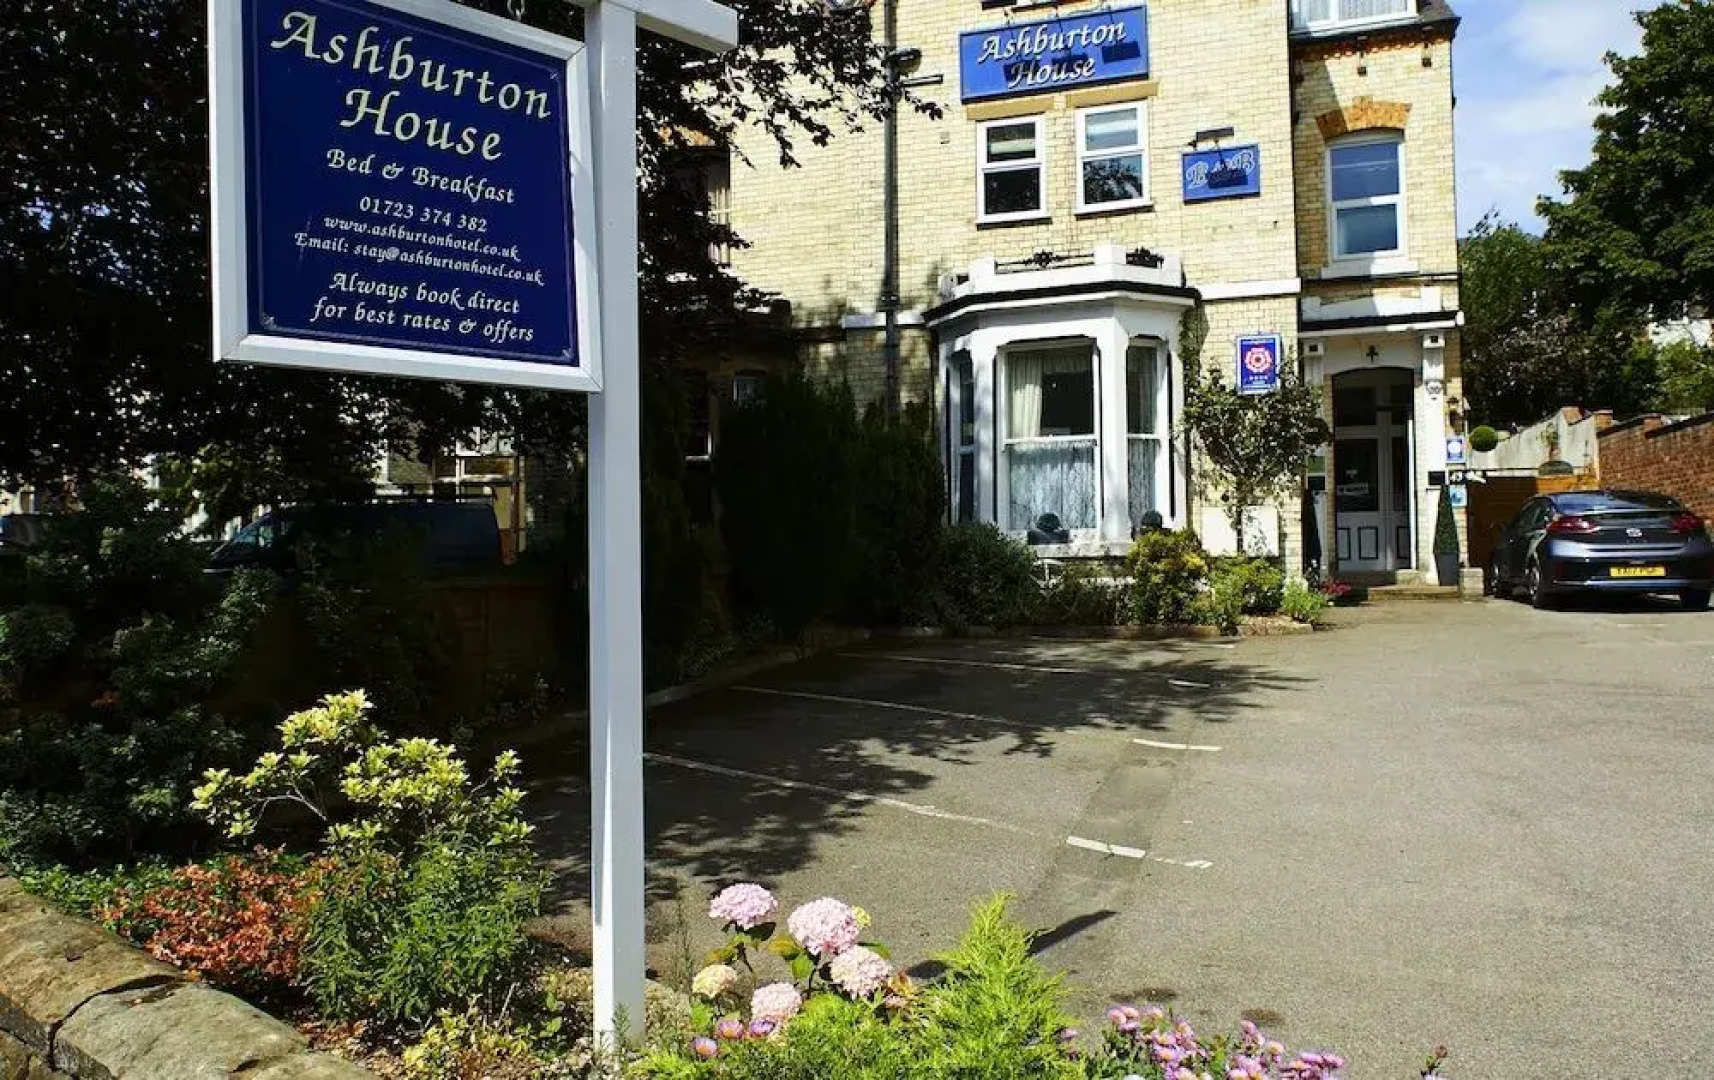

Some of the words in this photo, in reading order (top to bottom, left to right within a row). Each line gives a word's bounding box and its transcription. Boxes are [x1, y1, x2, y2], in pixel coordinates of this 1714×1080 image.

[271, 11, 550, 119] Ashburton
[977, 22, 1127, 63] Ashburton
[1008, 57, 1096, 88] House
[340, 89, 502, 160] House
[326, 149, 375, 174] Bed
[382, 163, 404, 180] &
[412, 166, 515, 203] Breakfast
[359, 196, 414, 219] 01723
[420, 207, 452, 226] 374
[457, 214, 487, 232] 382
[294, 232, 349, 253] Email:
[354, 244, 545, 286] stay@ashburtonhotel.co.uk
[324, 217, 521, 262] www.ashburtonhotel.co.uk
[329, 272, 408, 303] Always
[416, 283, 464, 310] book
[467, 290, 520, 314] direct
[310, 297, 347, 322] for
[355, 302, 395, 324] best
[403, 313, 451, 332] rates
[459, 319, 477, 333] &
[483, 319, 534, 343] offers
